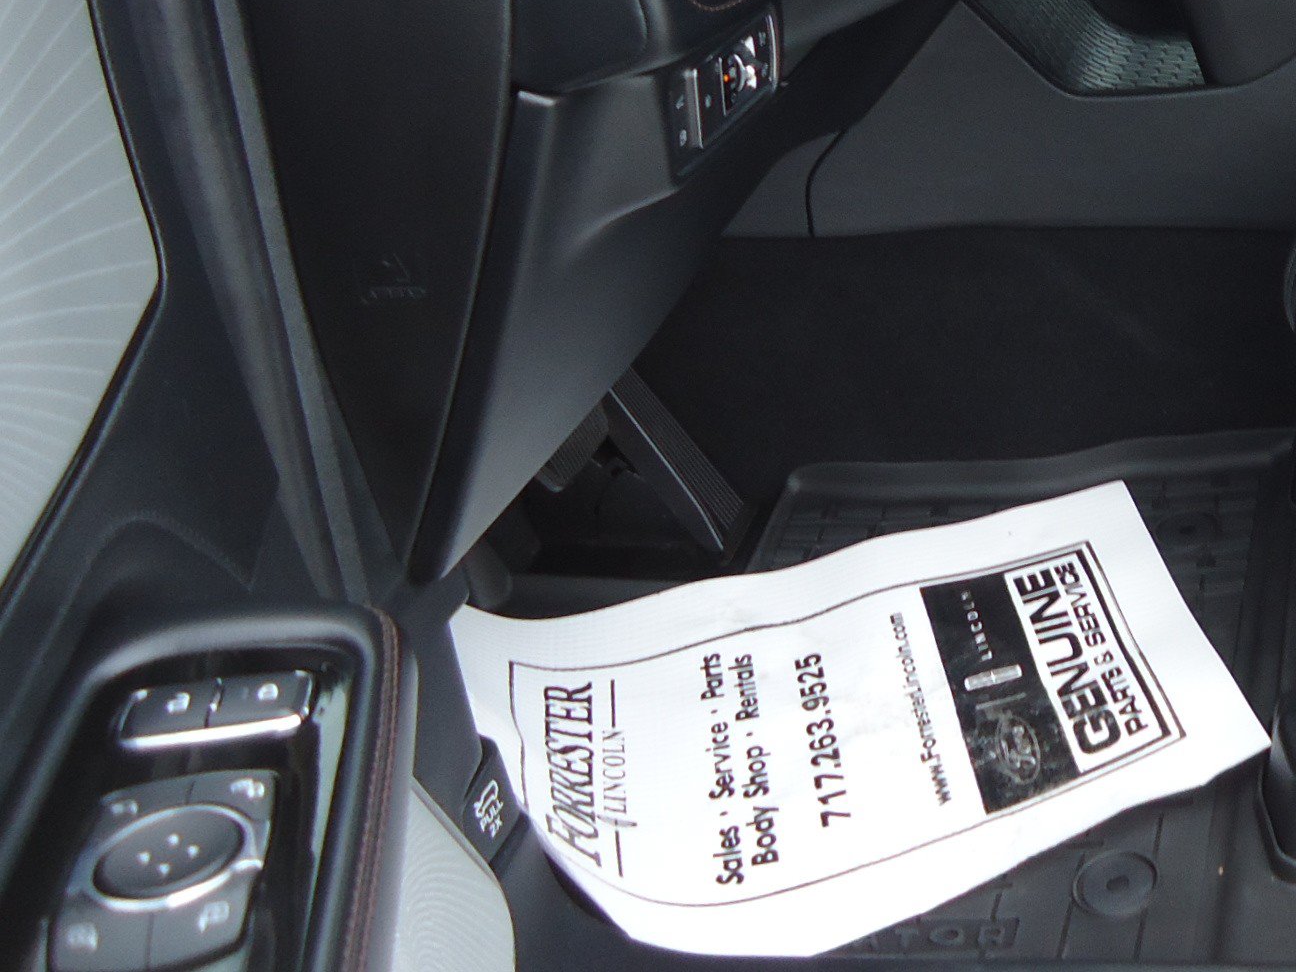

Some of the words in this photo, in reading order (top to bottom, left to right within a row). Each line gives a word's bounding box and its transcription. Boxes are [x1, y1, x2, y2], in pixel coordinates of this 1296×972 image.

[960, 589, 994, 664] LINCOLN
[1053, 562, 1107, 648] SERVICE
[700, 653, 725, 701] Parts
[727, 653, 761, 722] Rentals
[1012, 568, 1122, 755] GENUINE
[1093, 650, 1115, 666] &
[1101, 666, 1149, 736] PARTS
[544, 681, 601, 867] FORRESTER
[602, 730, 628, 814] LINCOLN
[705, 721, 735, 799] Service
[741, 745, 772, 799] Shop
[794, 652, 852, 828] 717.263.9525
[712, 825, 745, 885] Sales
[746, 806, 780, 866] Body
